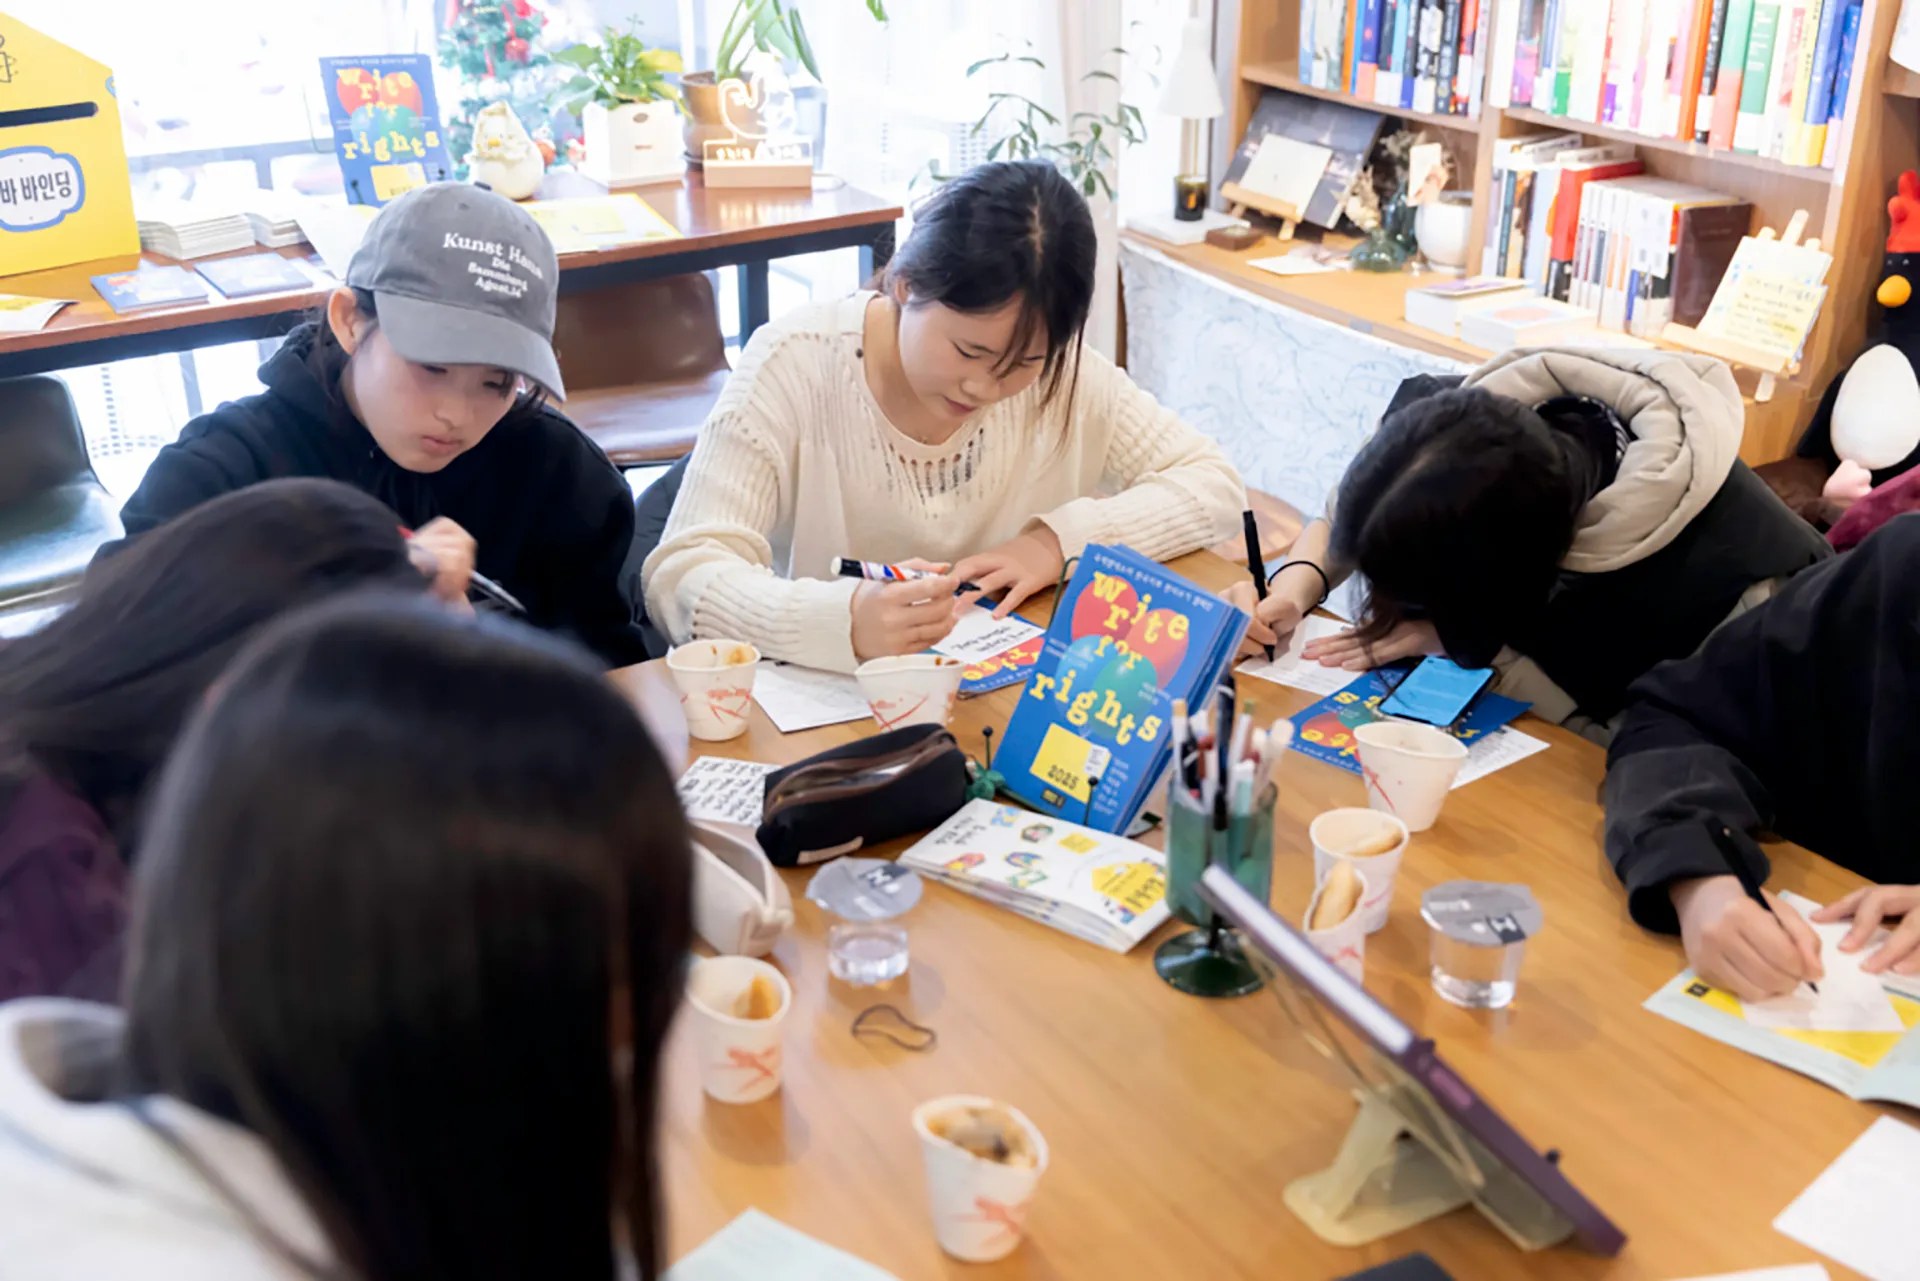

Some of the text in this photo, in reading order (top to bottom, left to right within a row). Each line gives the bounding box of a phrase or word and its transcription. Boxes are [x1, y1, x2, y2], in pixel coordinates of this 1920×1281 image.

[20, 171, 71, 202] 바인딩
[442, 232, 504, 256] Kunst
[1094, 635, 1143, 669] for
[1029, 669, 1162, 746] rights
[1047, 765, 1080, 790] 2025
